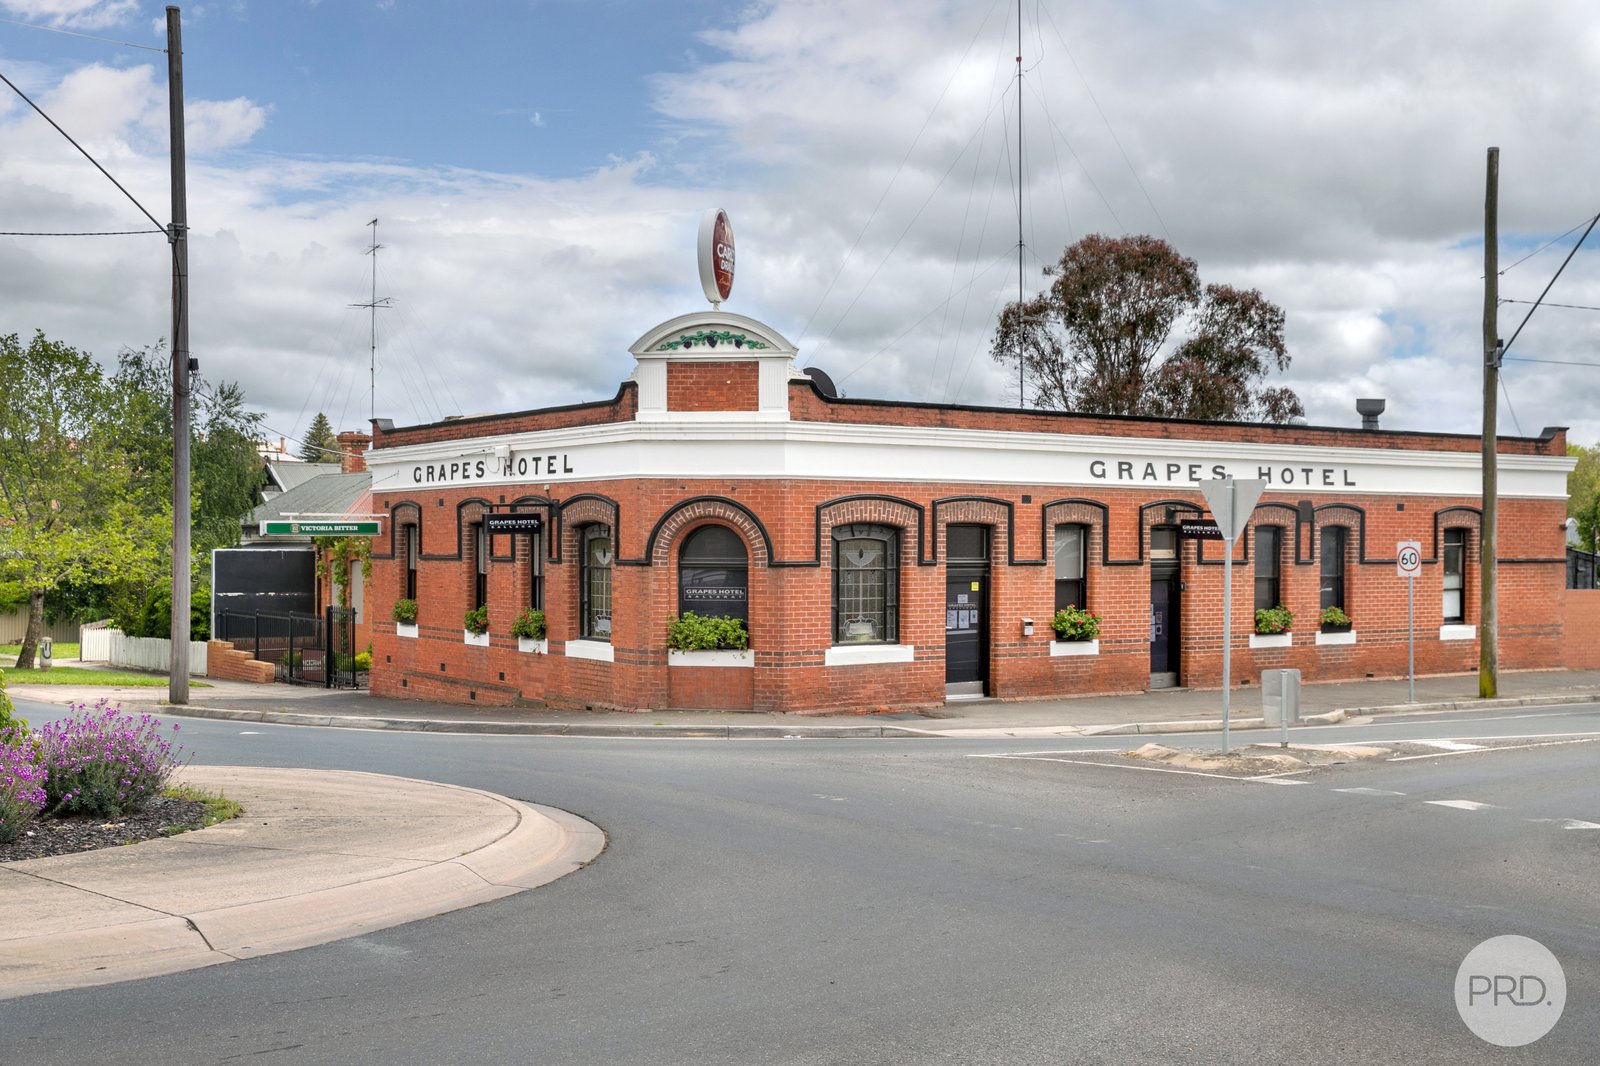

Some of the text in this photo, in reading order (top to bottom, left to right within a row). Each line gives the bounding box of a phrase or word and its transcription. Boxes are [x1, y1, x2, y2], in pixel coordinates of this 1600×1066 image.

[413, 454, 573, 483] GRAPES HOTEL
[1089, 460, 1356, 487] GRAPES HOTEL
[1401, 552, 1417, 565] 60
